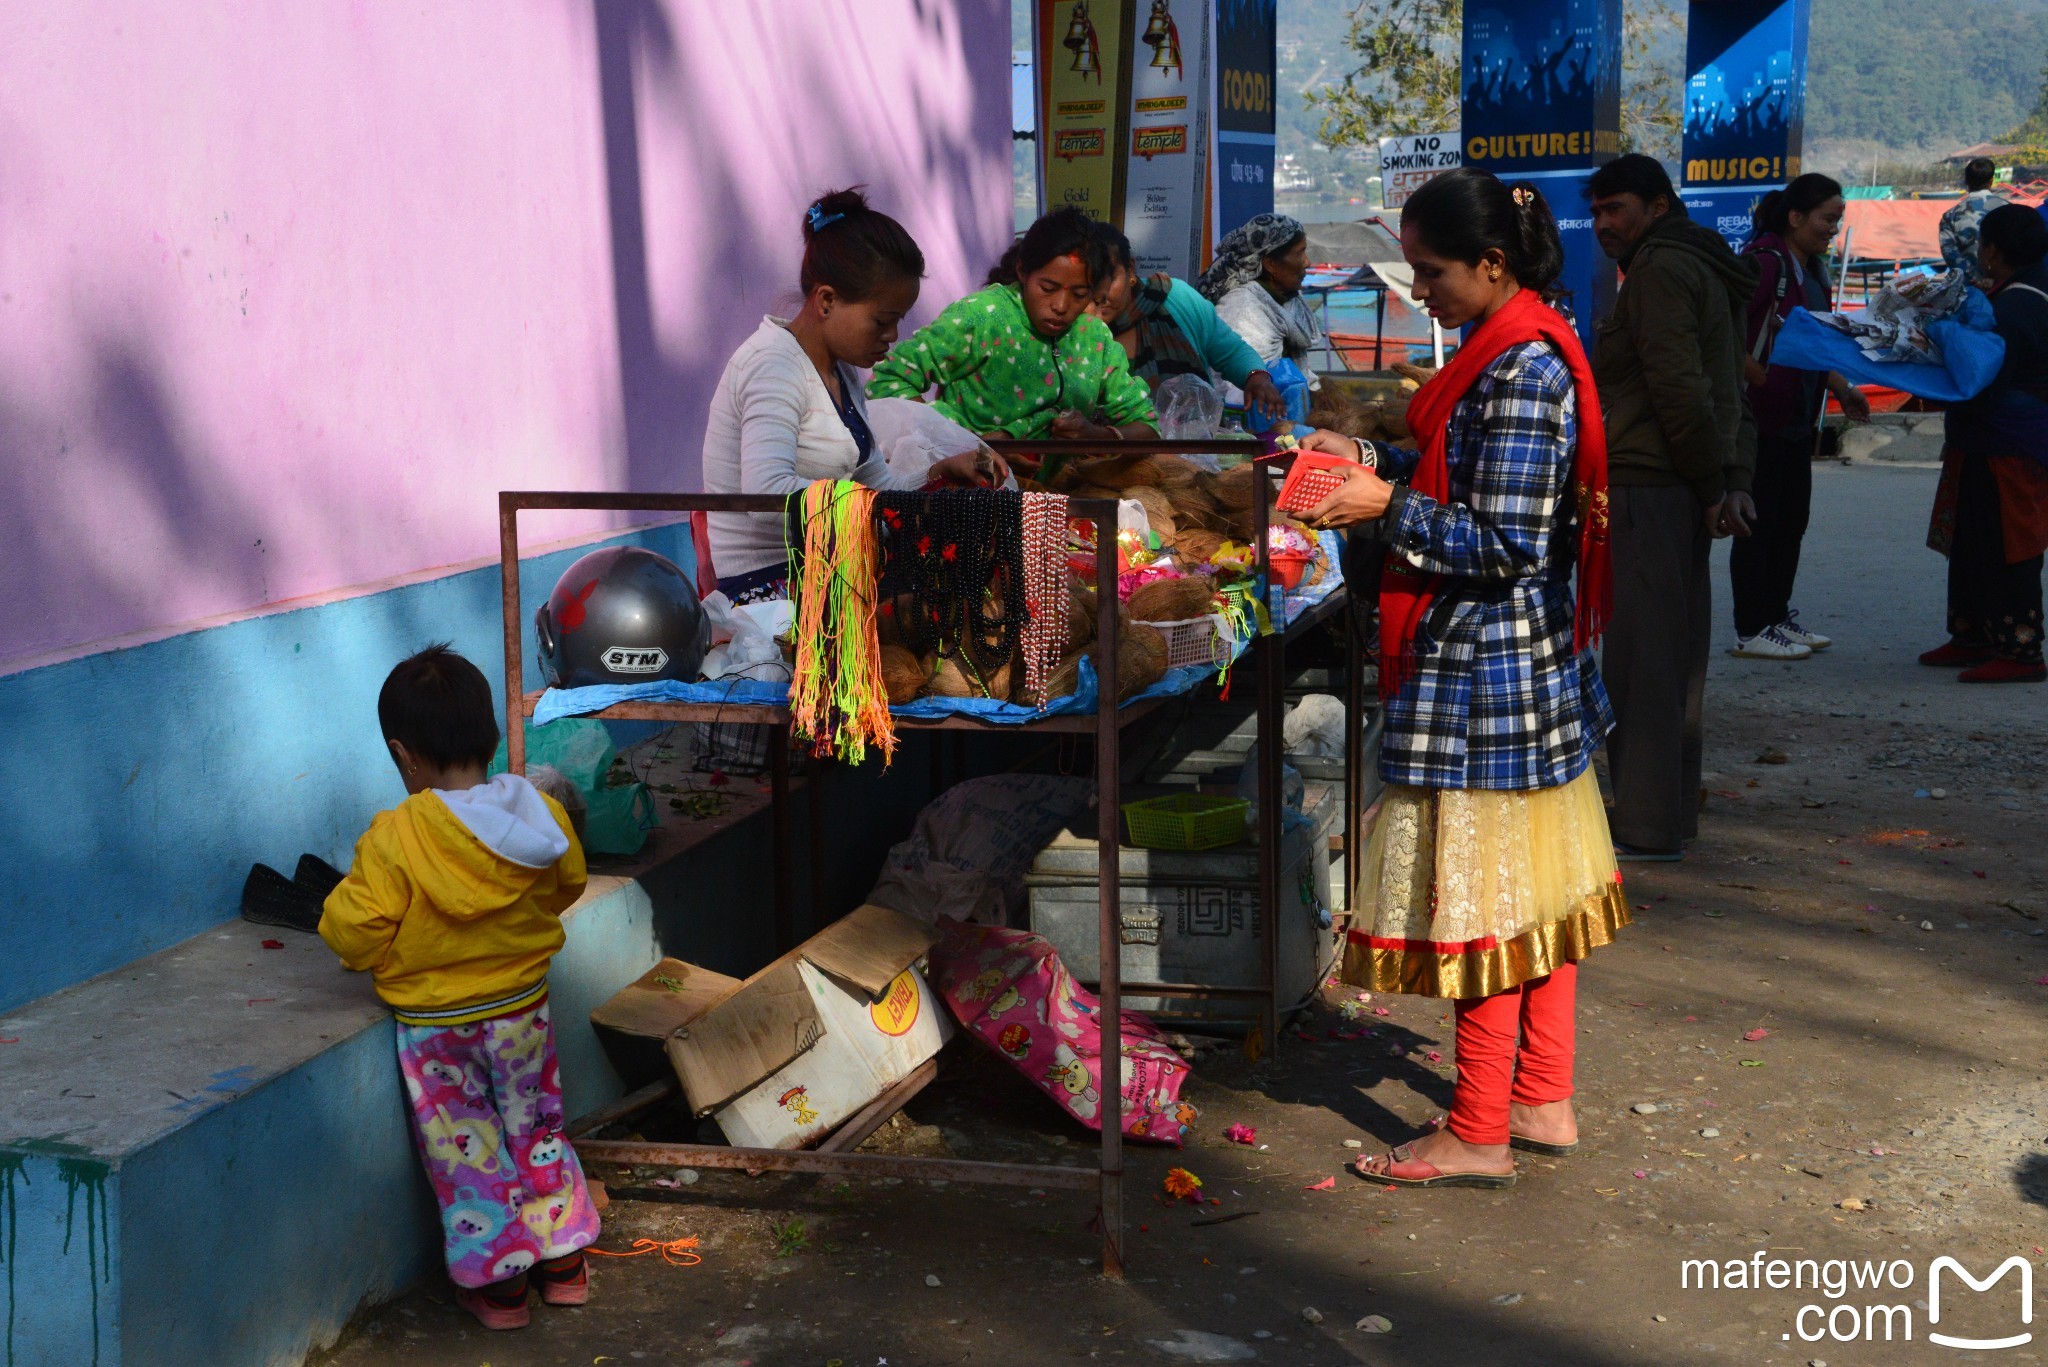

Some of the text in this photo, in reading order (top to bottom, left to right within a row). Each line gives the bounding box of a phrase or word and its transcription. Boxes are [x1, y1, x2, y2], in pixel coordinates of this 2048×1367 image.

[1223, 68, 1271, 113] FOOD!
[1058, 130, 1101, 155] temple
[1137, 127, 1183, 153] temple
[1414, 137, 1441, 153] NO
[1467, 131, 1591, 160] CULTURE!
[1382, 153, 1434, 170] SMOKING
[1687, 157, 1780, 181] MUSIC!
[1064, 187, 1089, 202] Gold
[1144, 203, 1168, 215] Edition
[609, 652, 660, 665] STM
